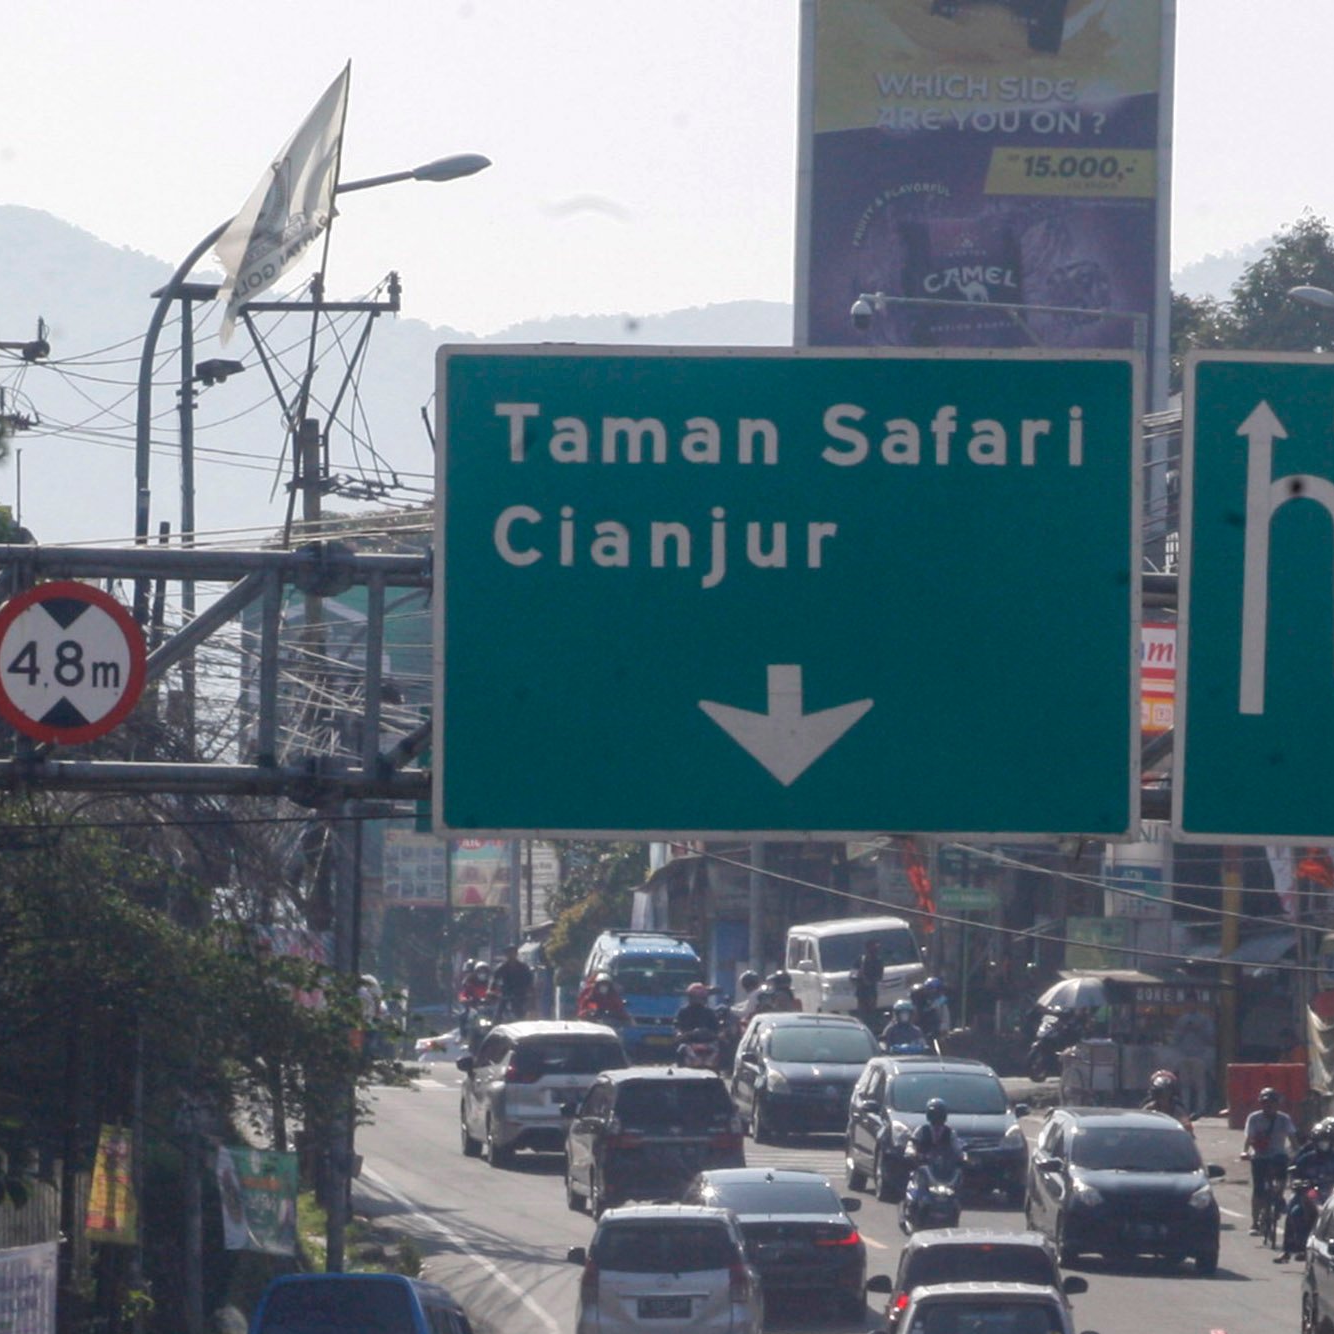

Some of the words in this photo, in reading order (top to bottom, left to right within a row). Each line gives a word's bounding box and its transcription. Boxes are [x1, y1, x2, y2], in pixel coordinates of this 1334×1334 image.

[875, 72, 987, 99] WHICH
[998, 76, 1076, 101] SIDE
[876, 105, 941, 131] ARE
[951, 107, 1019, 132] YOU
[1030, 111, 1080, 134] ON
[923, 265, 1017, 294] CAMEL
[496, 402, 779, 467] Taman
[822, 403, 1084, 468] Safari
[494, 504, 836, 589] Cianjur
